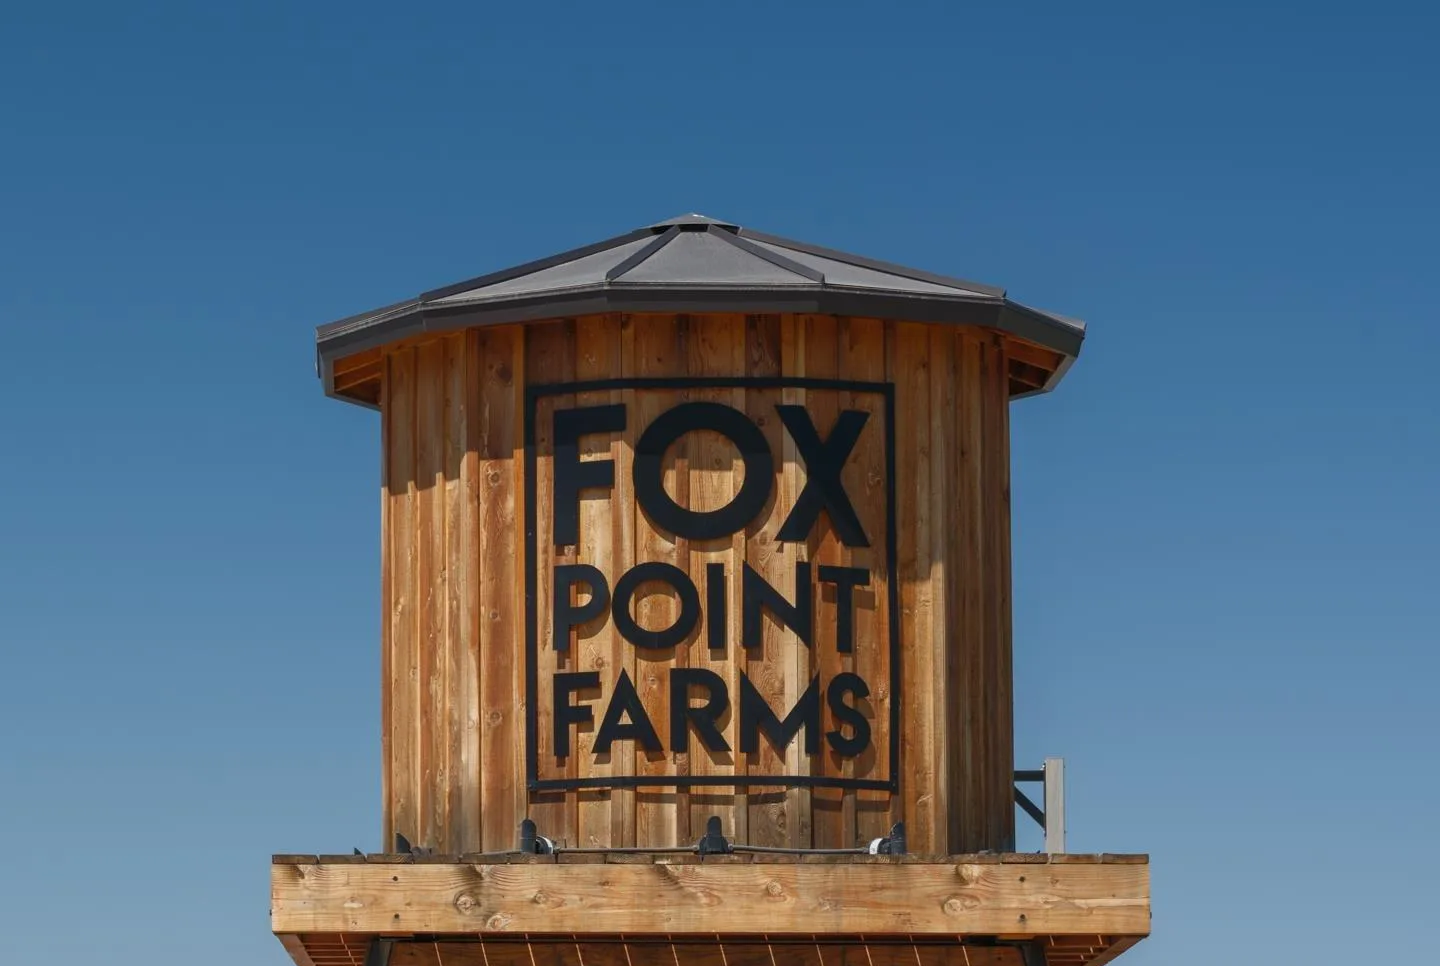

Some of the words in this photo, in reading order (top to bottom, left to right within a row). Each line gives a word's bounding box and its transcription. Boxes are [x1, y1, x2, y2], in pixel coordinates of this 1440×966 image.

[553, 402, 871, 548] FOX
[553, 561, 870, 653] POINT
[553, 667, 872, 758] FARMS
